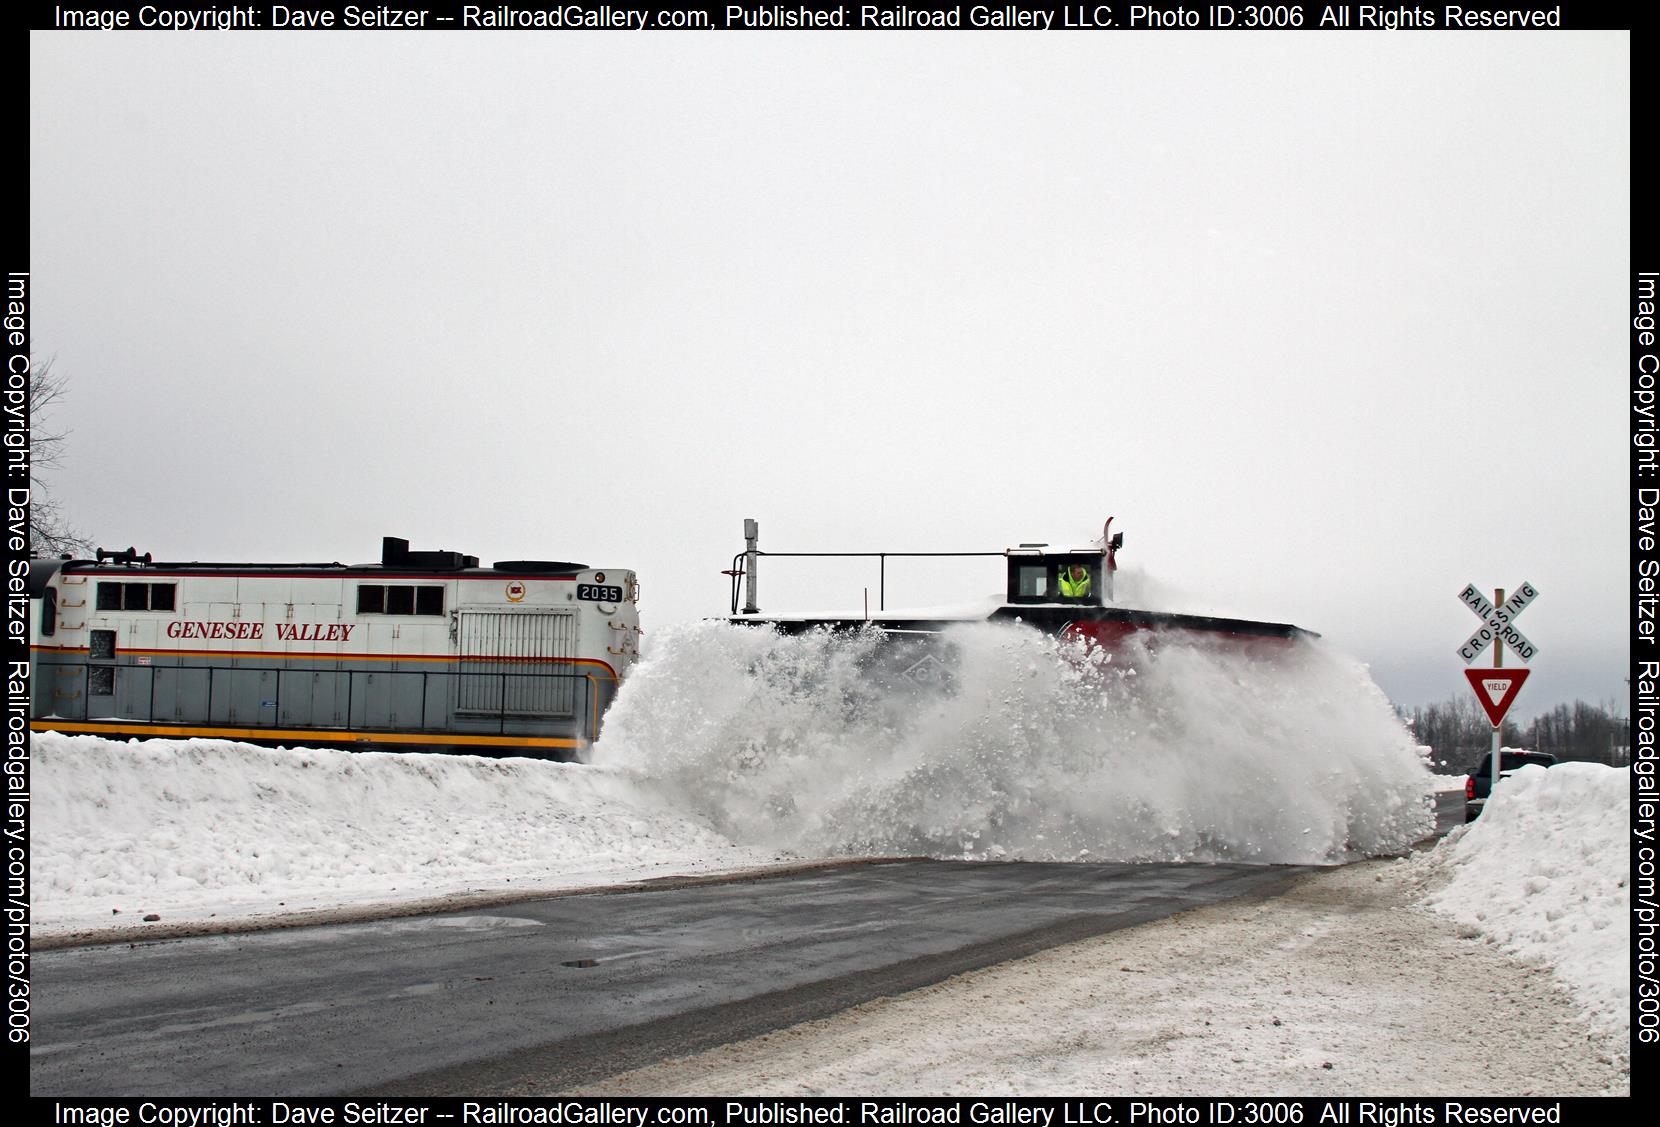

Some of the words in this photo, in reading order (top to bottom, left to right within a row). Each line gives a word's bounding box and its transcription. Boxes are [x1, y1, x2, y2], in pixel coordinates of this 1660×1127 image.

[581, 586, 617, 600] 2035
[167, 621, 264, 640] GENESEE
[275, 623, 355, 641] VALLEY
[1462, 586, 1534, 659] CROSSING
[1487, 683, 1507, 691] YIELD
